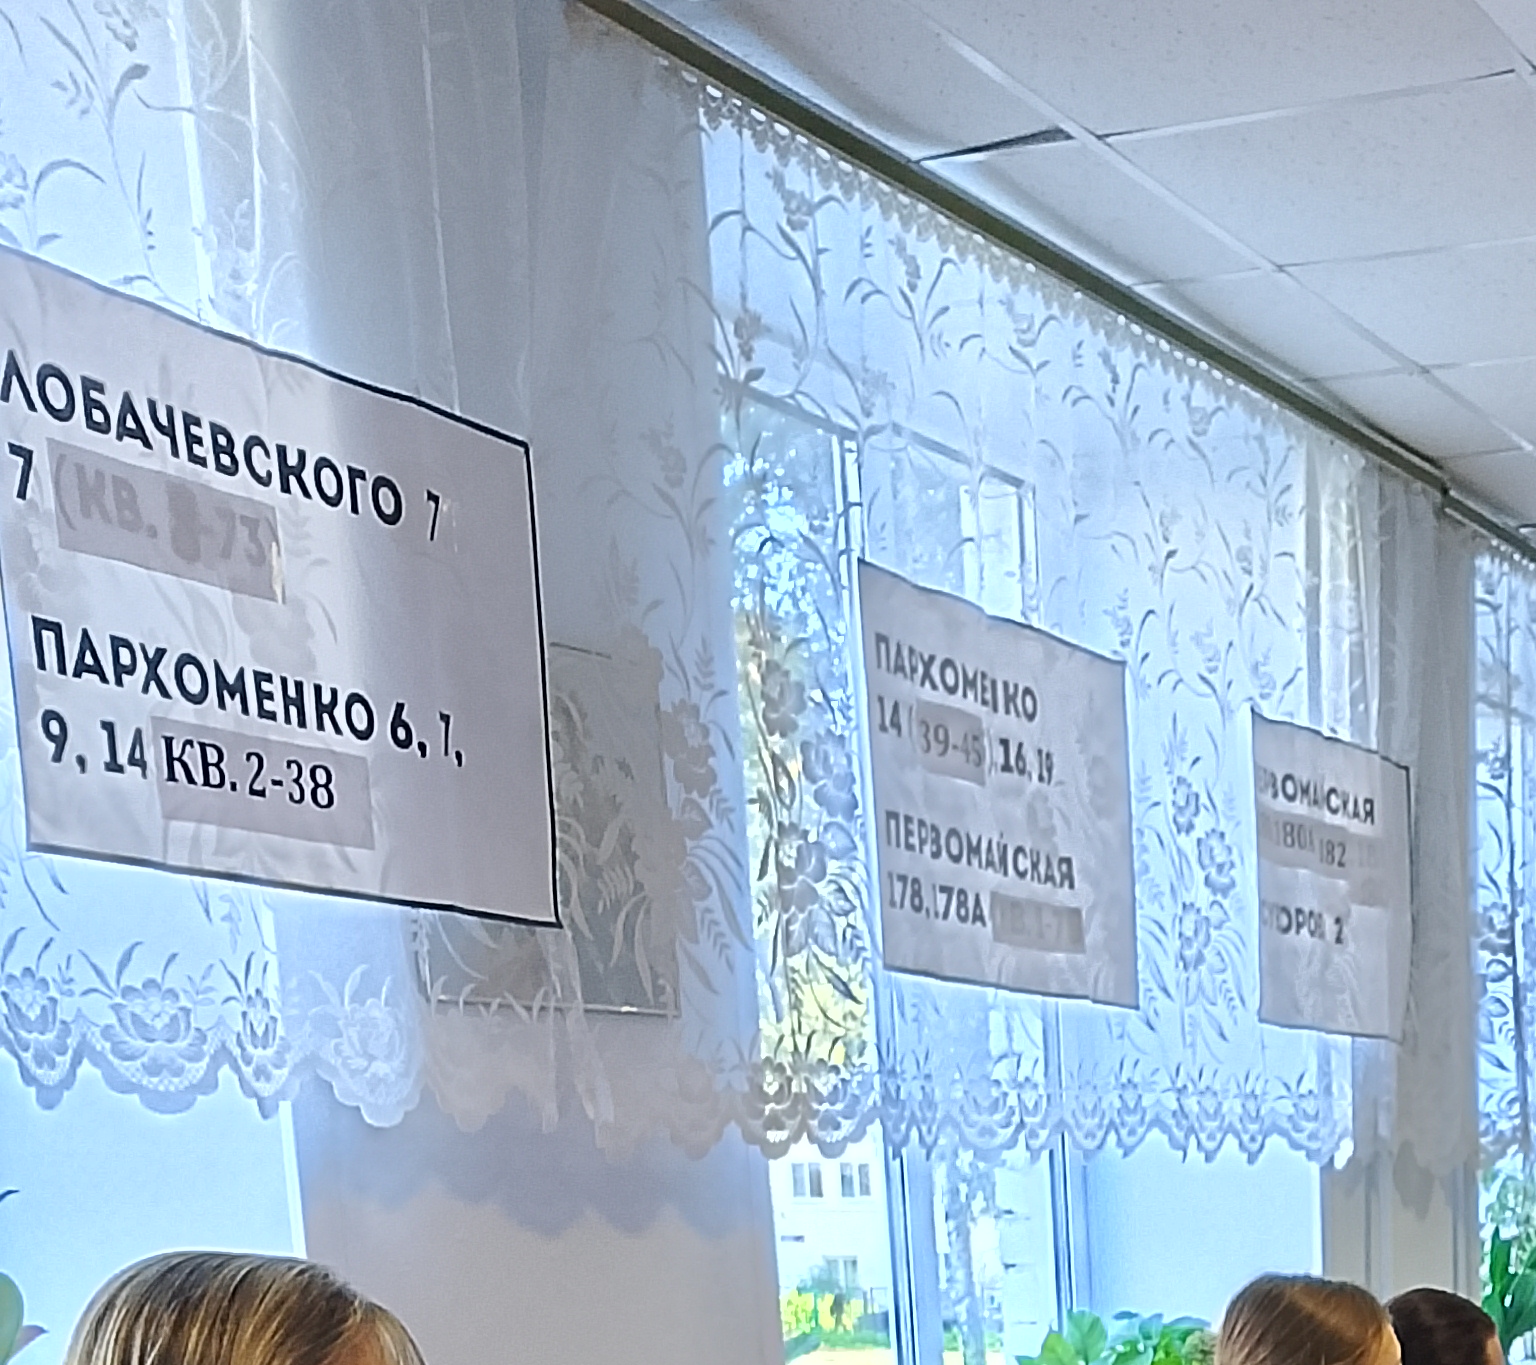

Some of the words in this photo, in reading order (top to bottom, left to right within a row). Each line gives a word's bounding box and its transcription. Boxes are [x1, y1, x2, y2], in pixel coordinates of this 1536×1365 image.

[0, 349, 403, 527] ЛОБАЧЕВСКОГО
[7, 441, 34, 501] 7
[31, 615, 376, 740] ПАРХОМЕНКО
[390, 701, 427, 758] 6,
[877, 694, 902, 738] 14
[41, 709, 88, 774] 9,
[100, 721, 148, 779] 14
[885, 810, 1076, 890] ПЕРВОМАЙСКАЯ
